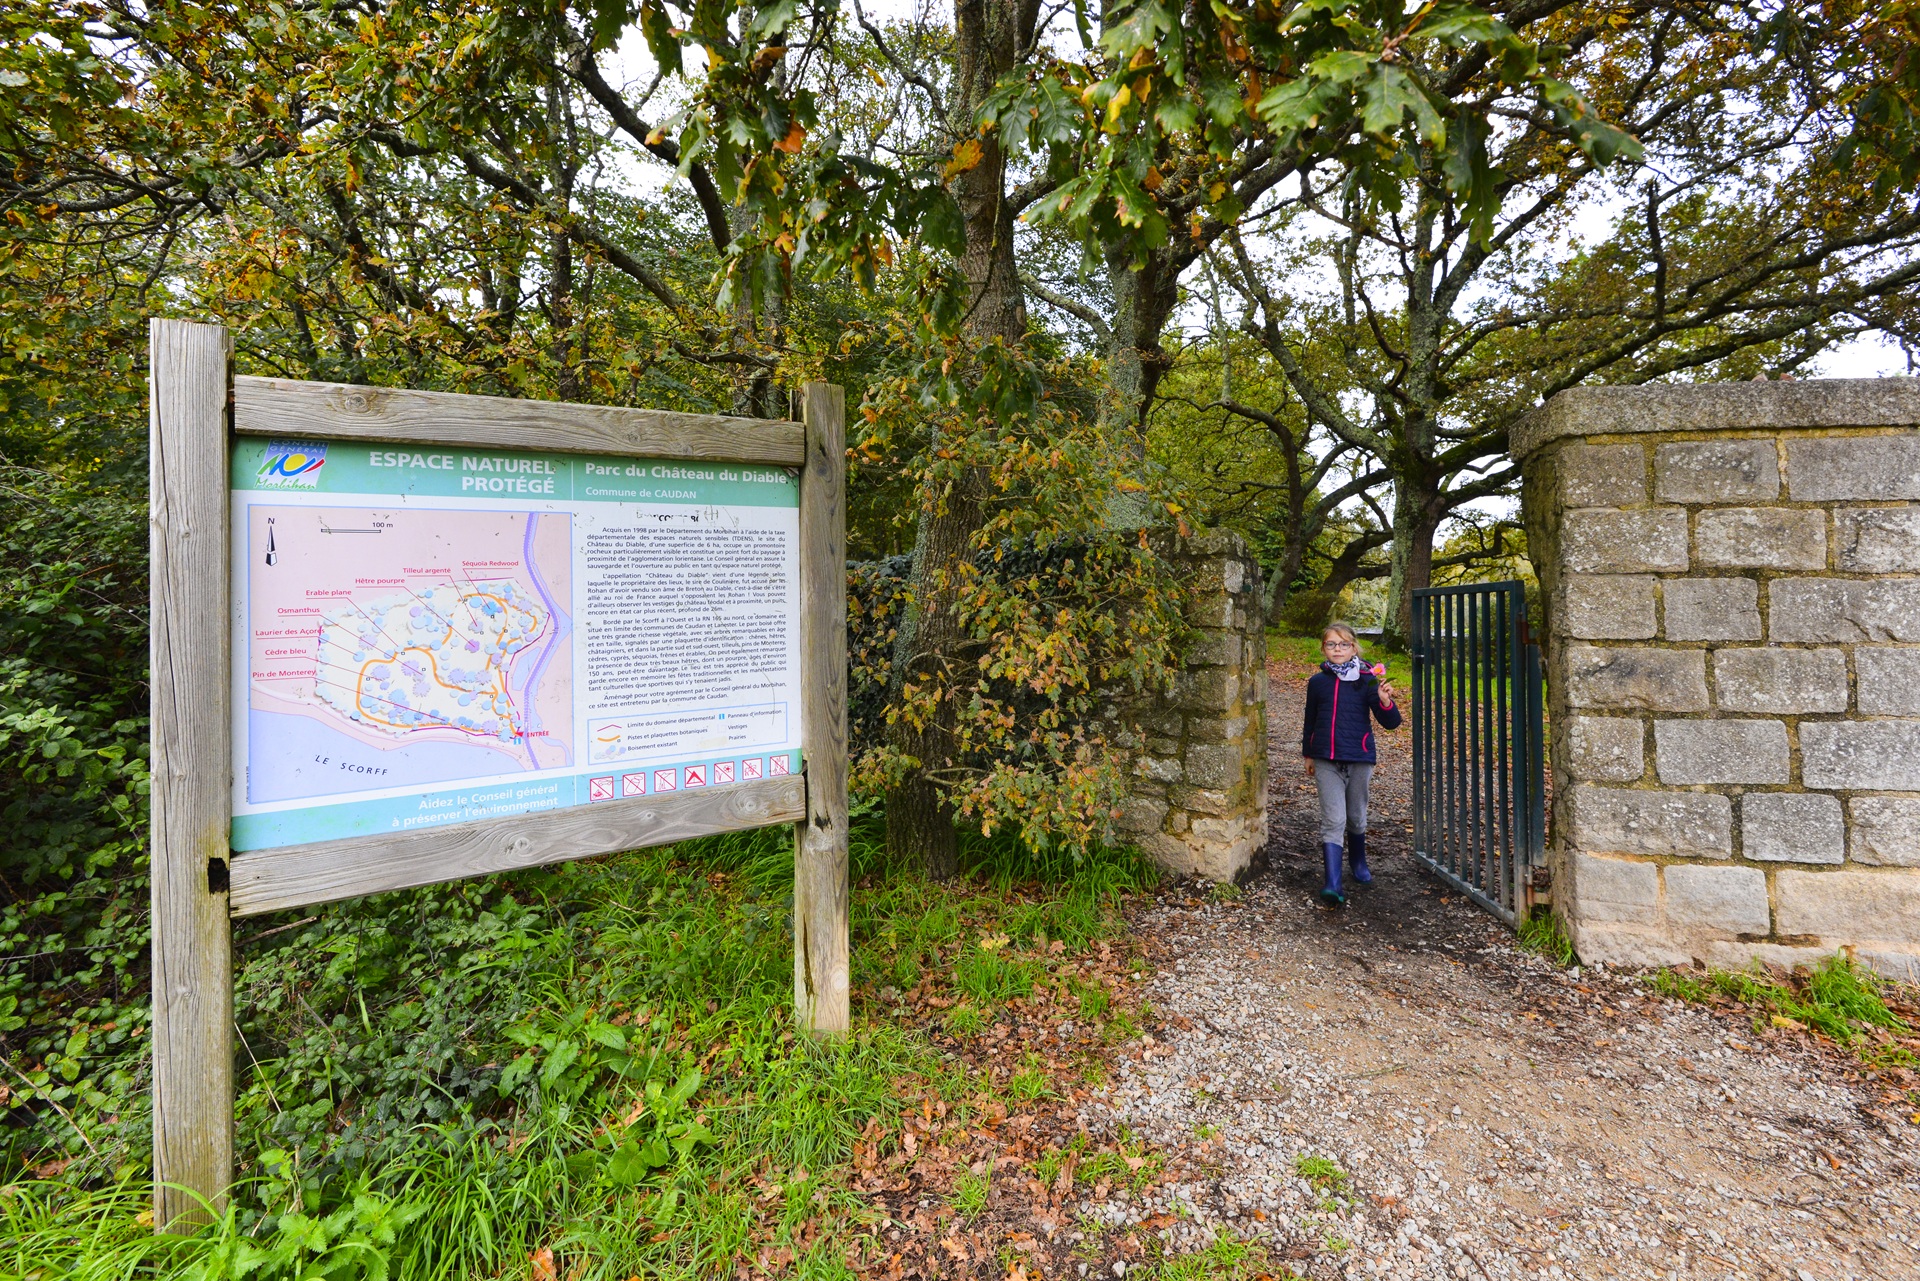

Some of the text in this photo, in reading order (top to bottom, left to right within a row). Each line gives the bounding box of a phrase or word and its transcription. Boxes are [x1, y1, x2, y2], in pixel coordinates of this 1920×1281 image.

[370, 452, 555, 474] ESPACE NATUREL
[255, 477, 315, 489] Morbihan
[586, 463, 786, 484] Parc du Château du Diable
[462, 476, 554, 494] PROTÉGÉ
[586, 487, 696, 499] Commune de CAUDAN
[750, 710, 782, 718] d'information
[315, 755, 387, 775] LE SCORFF
[419, 784, 558, 810] Aidez le Conseil général
[392, 797, 558, 827] à préserver l'environnement
